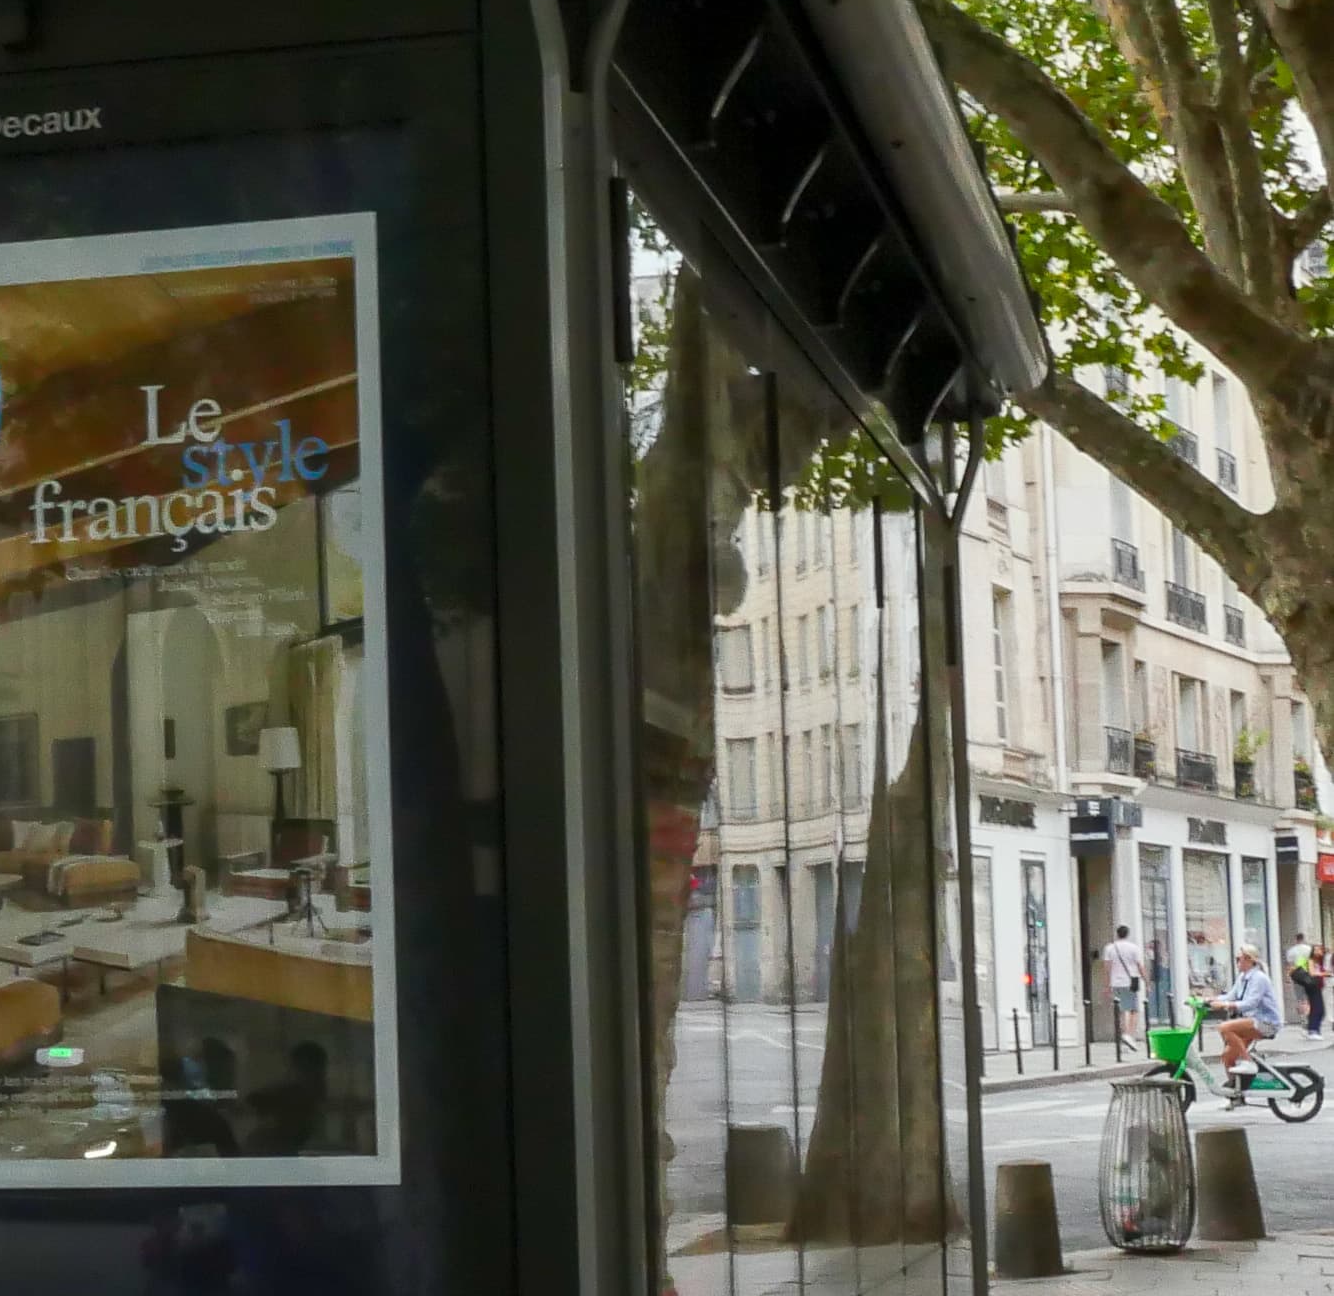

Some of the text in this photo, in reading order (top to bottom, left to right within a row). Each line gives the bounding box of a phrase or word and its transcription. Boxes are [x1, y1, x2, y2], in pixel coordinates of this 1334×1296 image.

[138, 384, 223, 446] Le
[180, 418, 329, 502] style
[28, 468, 279, 552] français
